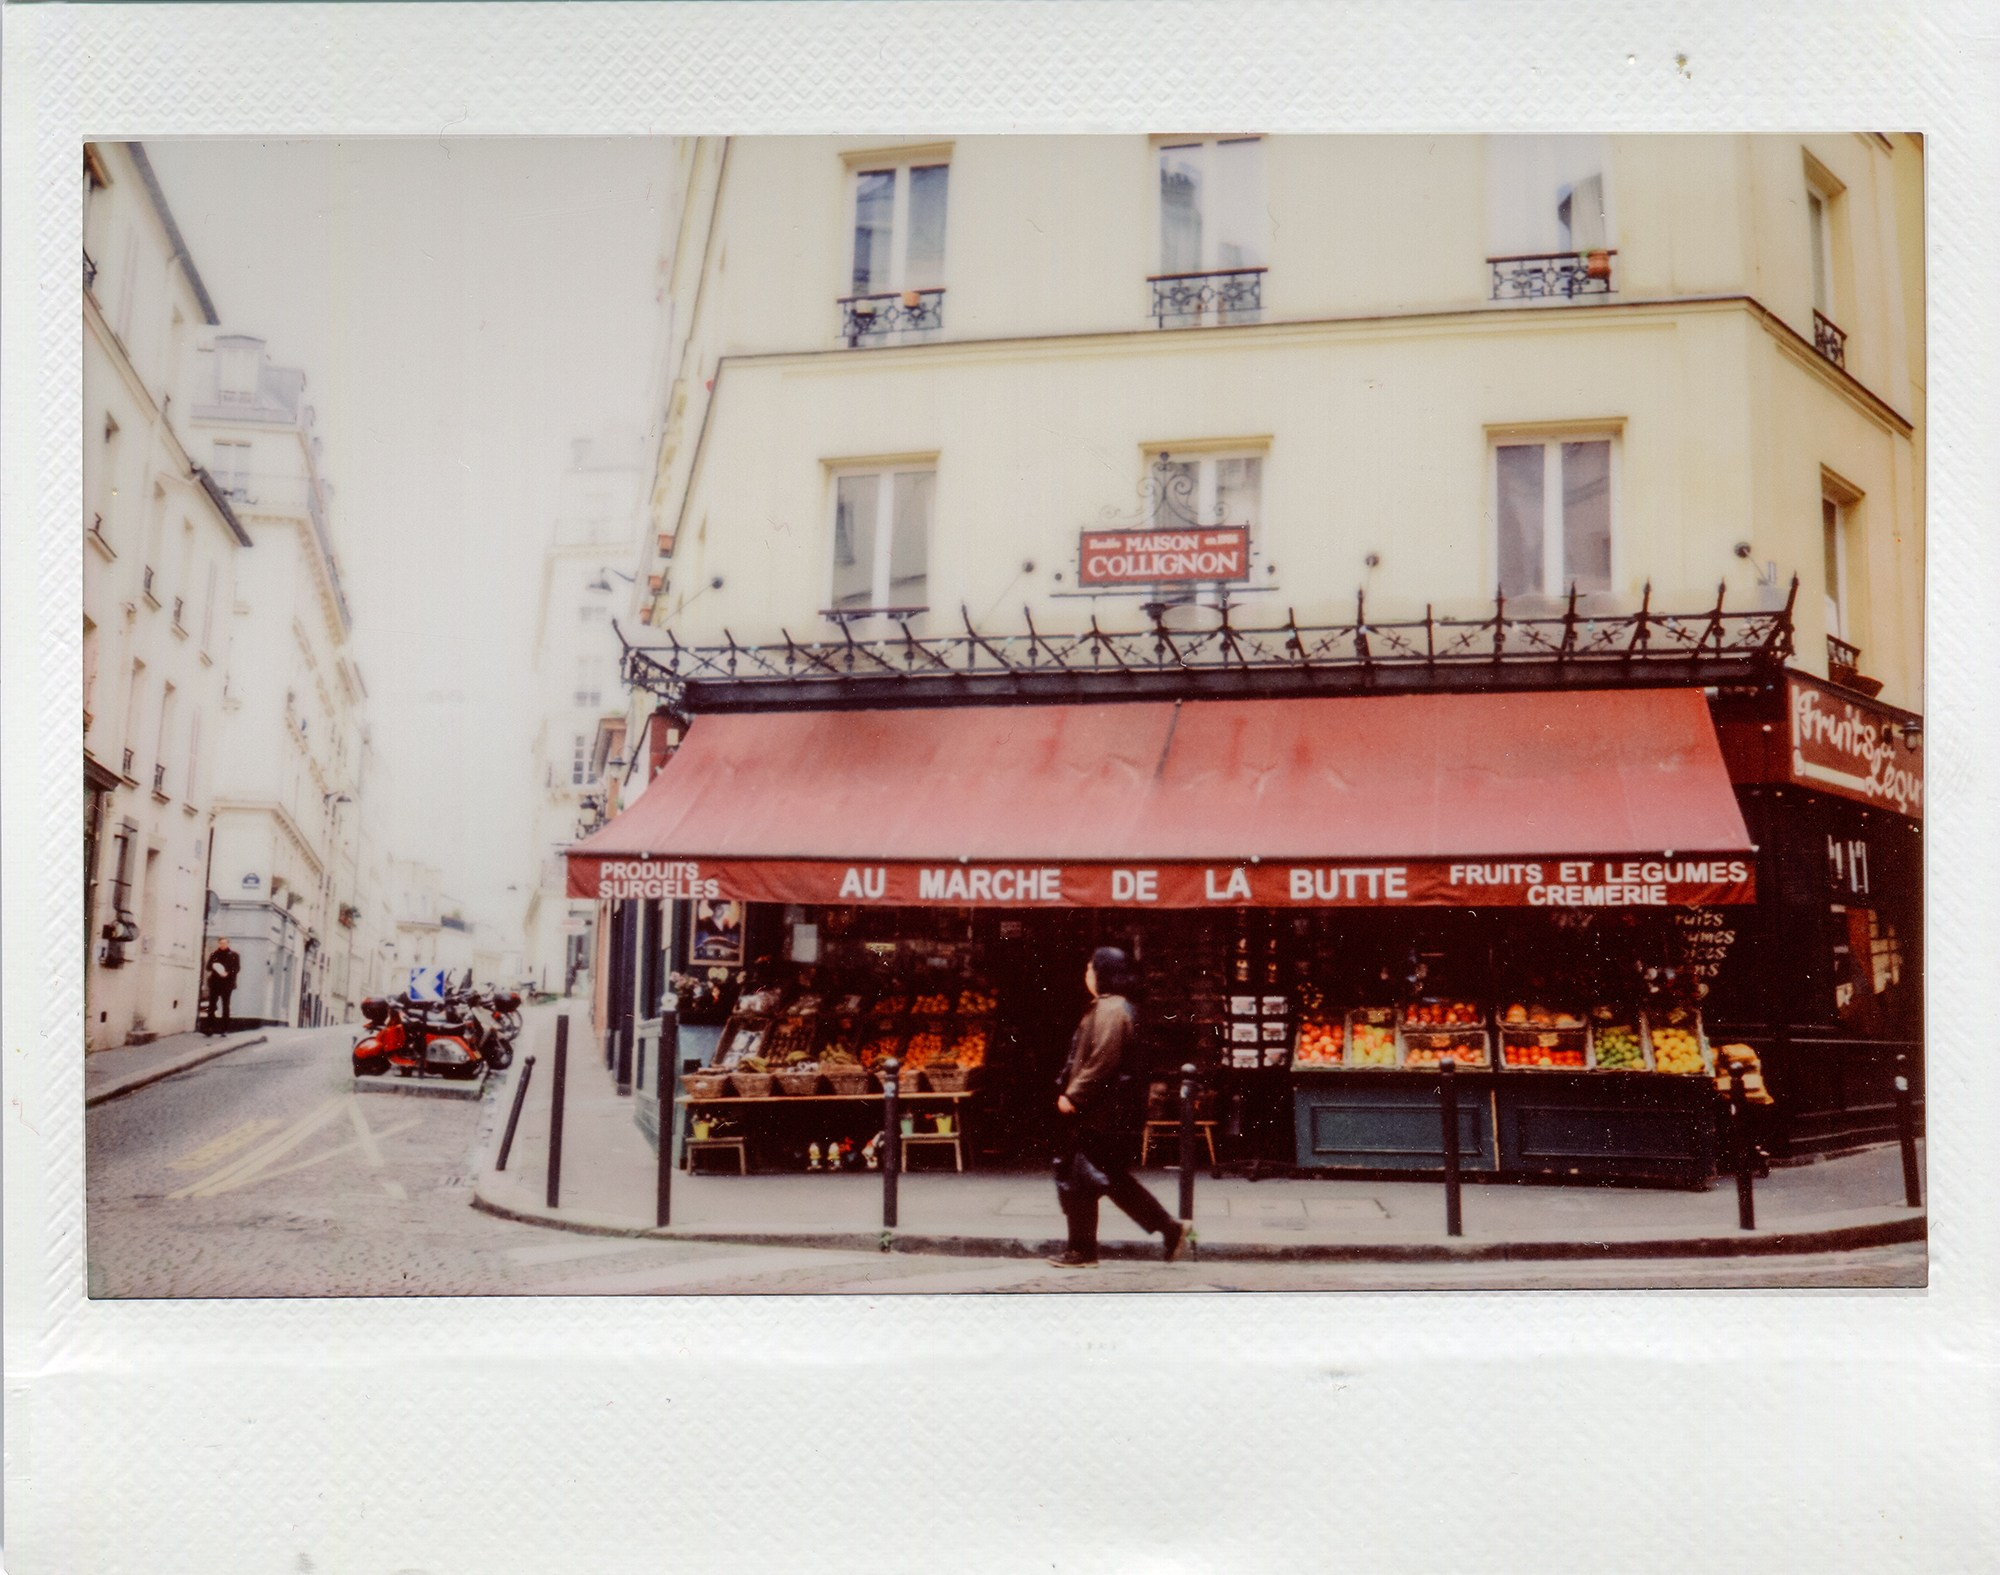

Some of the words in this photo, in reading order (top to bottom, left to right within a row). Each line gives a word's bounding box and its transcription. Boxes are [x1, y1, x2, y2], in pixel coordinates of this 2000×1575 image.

[1125, 535, 1199, 552] MAISON
[1087, 551, 1239, 577] COLLIGNON
[601, 862, 699, 880] PRODUITS
[1450, 863, 1543, 885] FRUITS
[1560, 862, 1594, 883] ET
[1605, 862, 1748, 883] LEGUMES
[599, 879, 719, 898] SURGELES
[839, 867, 886, 898] AU
[919, 869, 1061, 900] MARCHE
[1112, 869, 1158, 900] DE
[1205, 868, 1252, 899] LA
[1289, 867, 1408, 899] BUTTE
[1527, 885, 1668, 906] CREMERIE
[1674, 908, 1724, 927] ruits
